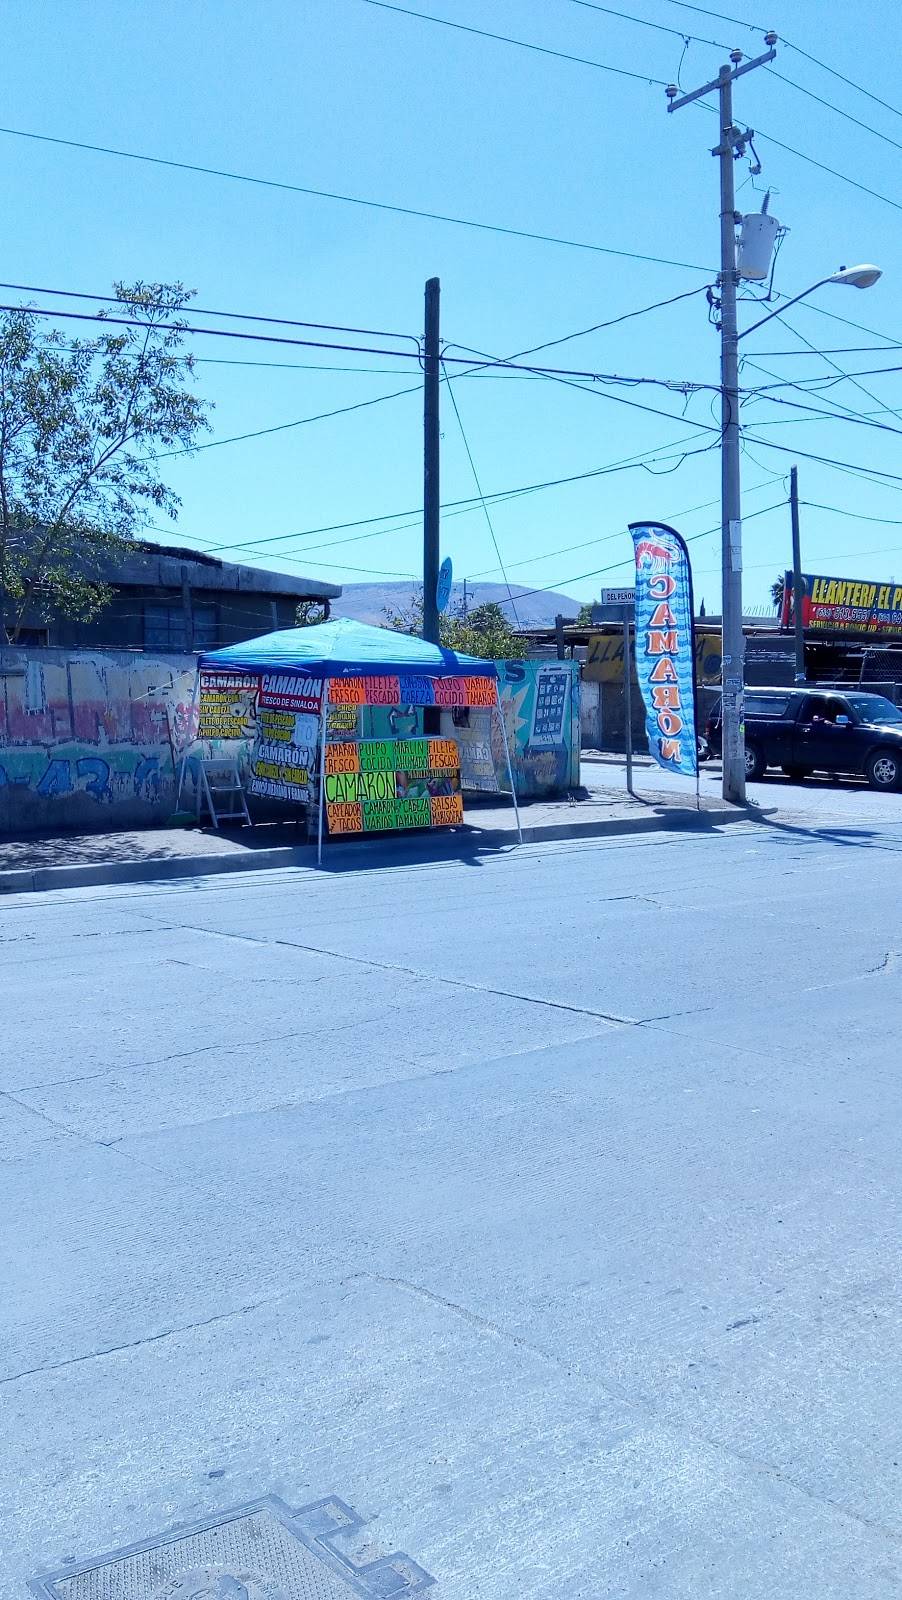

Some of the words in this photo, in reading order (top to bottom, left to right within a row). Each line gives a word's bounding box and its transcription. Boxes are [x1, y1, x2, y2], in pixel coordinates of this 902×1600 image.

[607, 593, 617, 601] DEL
[811, 579, 876, 608] LLANTERA
[877, 585, 891, 608] EL
[200, 675, 259, 688] CAMARÓN
[262, 674, 321, 698] CAMARÓN
[464, 678, 494, 691] VARIOS
[330, 689, 360, 704] FRESCO
[365, 690, 399, 705] PESCADO
[401, 690, 432, 704] CABEZA
[435, 691, 464, 704] COCIDO
[281, 698, 291, 707] DE
[291, 699, 319, 710] SINALOA
[258, 744, 309, 766] CAMARÓN
[359, 742, 387, 756] PULPO
[394, 741, 424, 755] MARLIN
[360, 758, 393, 771] COCIDO
[395, 755, 428, 770] AHUMADO
[429, 754, 459, 769] PESCADO
[325, 771, 396, 803] CAMARON
[328, 803, 361, 818] CAPEADOR
[363, 800, 396, 815] CAMARON
[403, 799, 429, 813] CABEZA
[431, 796, 458, 812] SALSAS
[339, 817, 362, 831] TACOS
[365, 815, 392, 829] VARIOS
